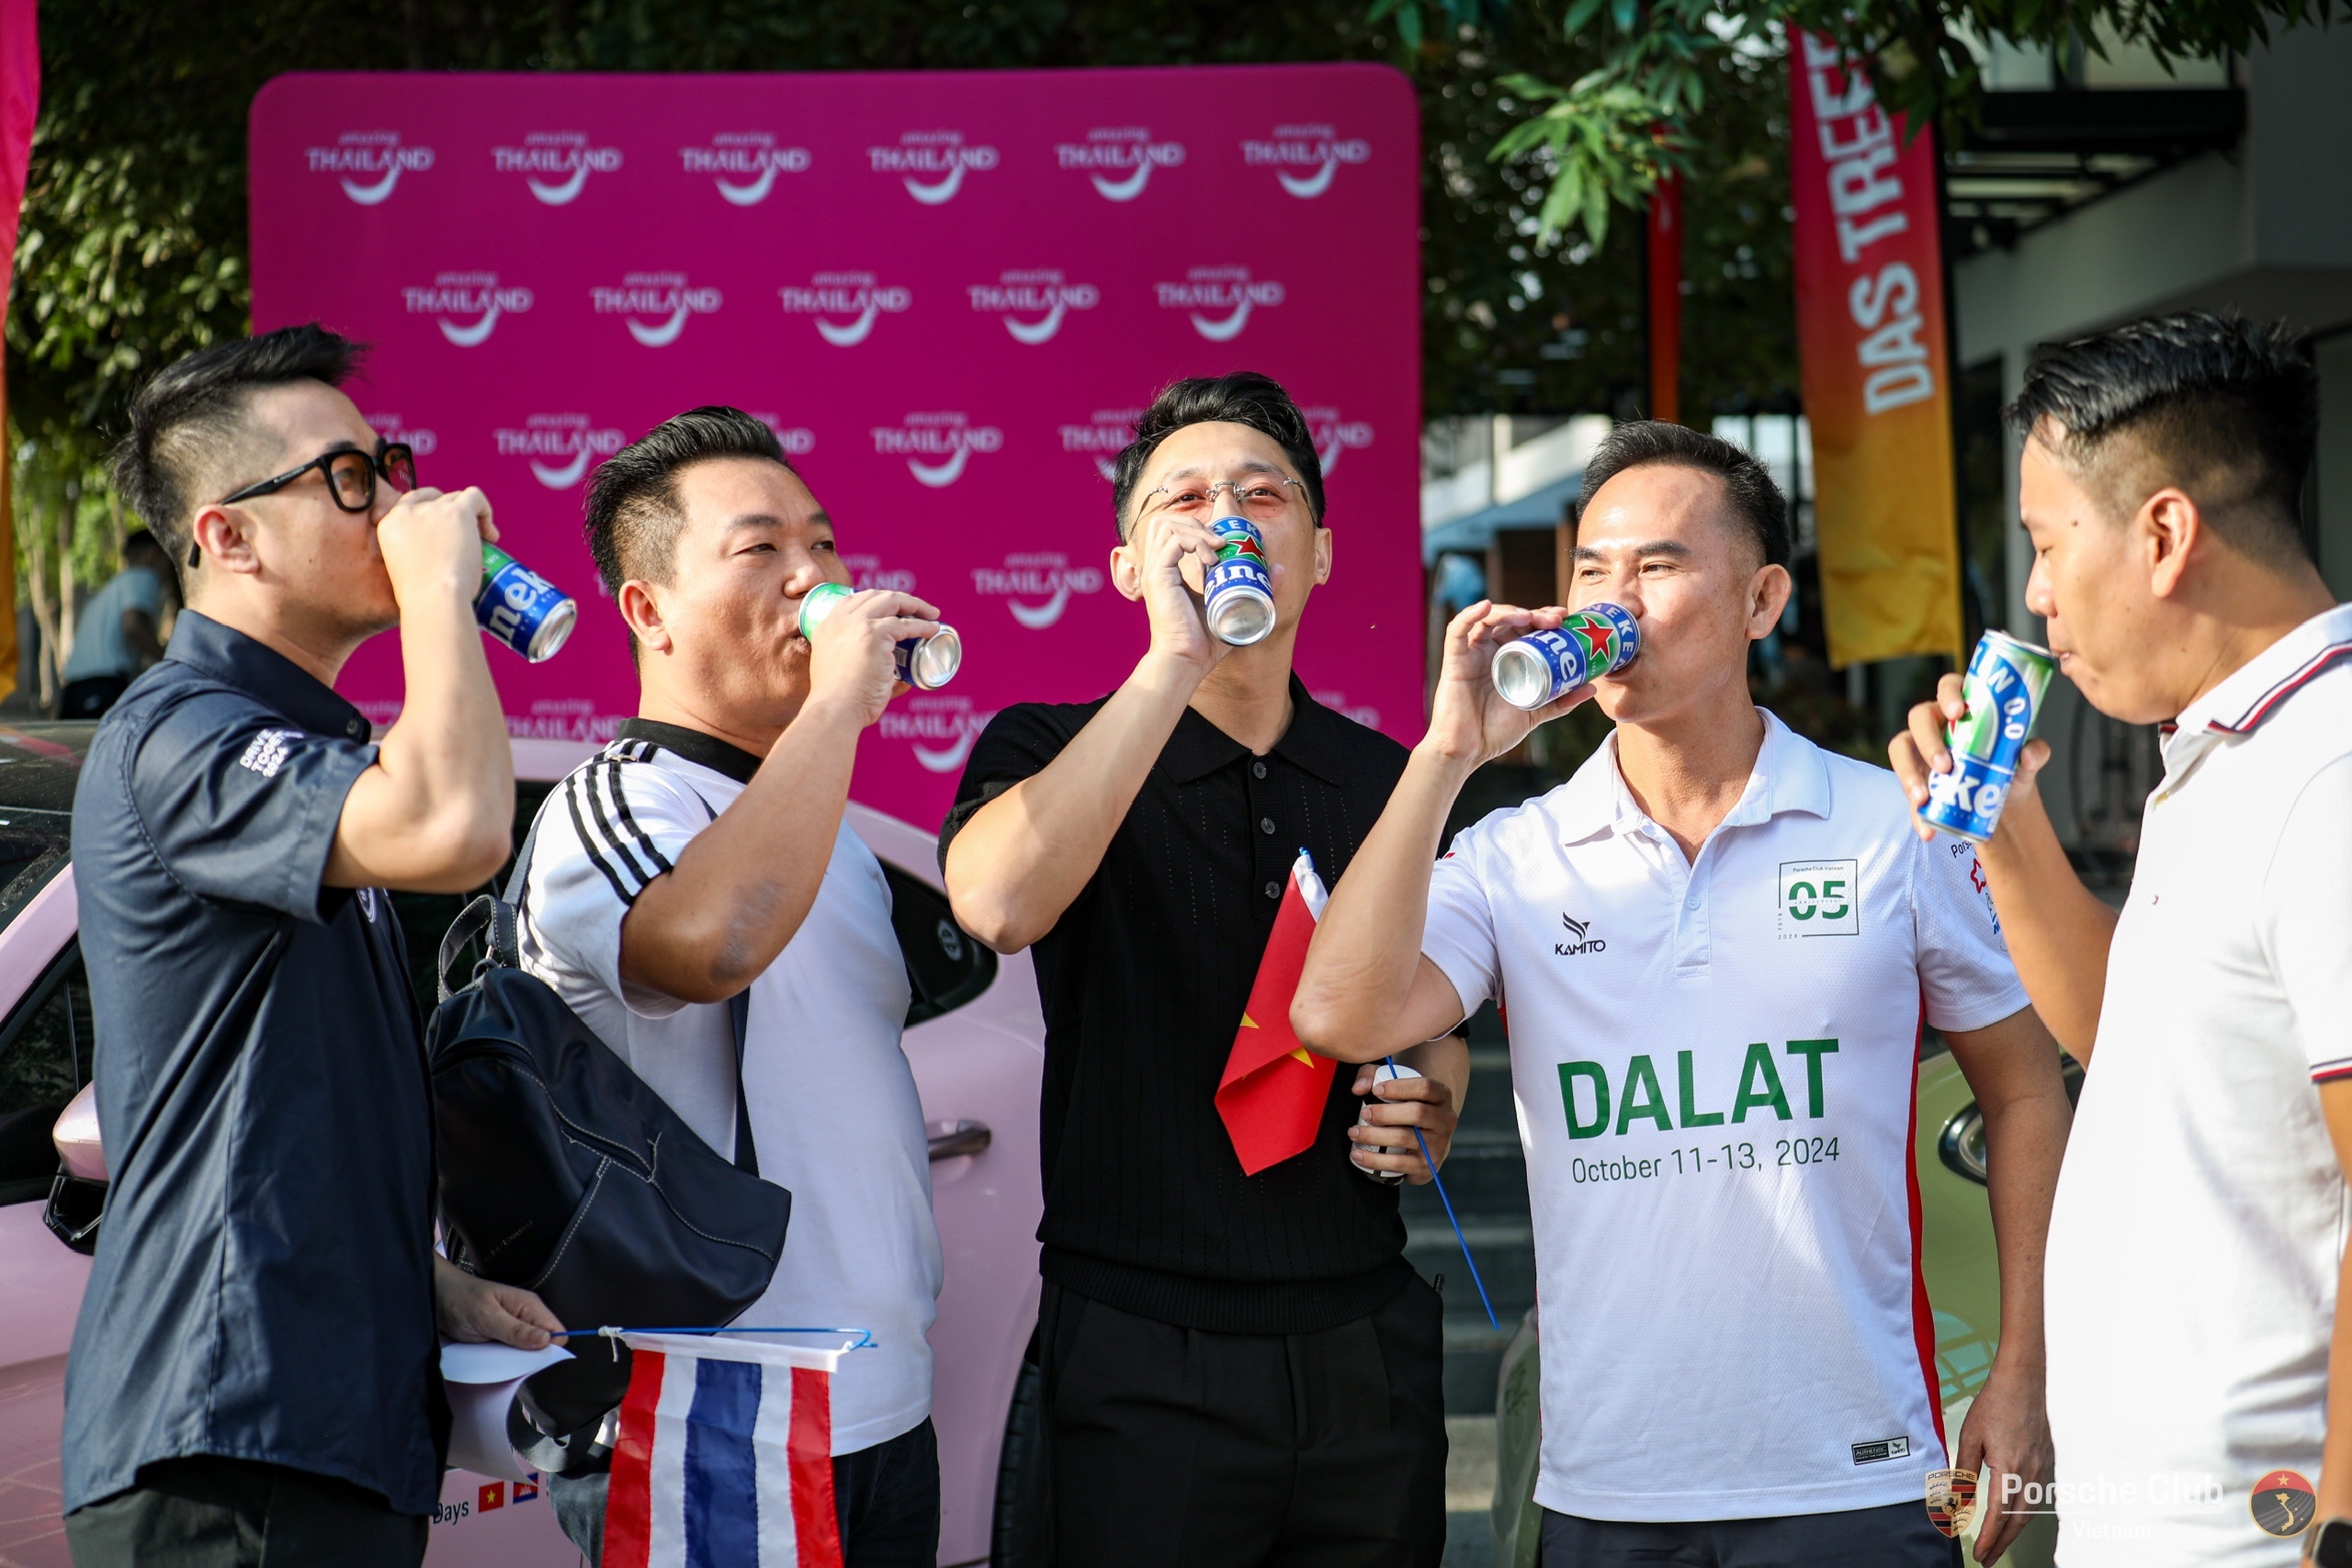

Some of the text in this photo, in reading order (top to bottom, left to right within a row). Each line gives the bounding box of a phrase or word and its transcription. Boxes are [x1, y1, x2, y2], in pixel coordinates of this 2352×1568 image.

[339, 131, 400, 146] amazing
[526, 131, 587, 146] amazing
[713, 131, 775, 146] amazing
[901, 130, 963, 146] amazing
[1088, 127, 1149, 142] amazing
[1274, 124, 1335, 140] amazing
[308, 147, 434, 172] THAILAND
[493, 147, 621, 172] THAILAND
[682, 148, 809, 172] THAILAND
[869, 147, 997, 172] THAILAND
[1057, 143, 1183, 169] THAILAND
[1242, 140, 1368, 165] THAILAND
[435, 272, 498, 288] amazing
[624, 272, 687, 288] amazing
[812, 272, 876, 288] amazing
[1001, 269, 1064, 285] amazing
[1188, 266, 1250, 282] amazing
[404, 288, 532, 314] THAILAND
[593, 288, 720, 314] THAILAND
[781, 288, 910, 314] THAILAND
[969, 286, 1098, 310] THAILAND
[1157, 283, 1283, 308] THAILAND
[1846, 261, 1936, 418] DAS
[526, 413, 590, 429] amazing
[904, 412, 967, 427] amazing
[494, 429, 625, 455] THAILAND
[873, 427, 1001, 453] THAILAND
[1057, 425, 1133, 452] THAIL
[1004, 553, 1068, 569] amazing
[973, 568, 1102, 595] THAILAND
[491, 566, 556, 649] nek
[531, 698, 594, 715] amazing
[909, 695, 971, 712] amazing
[879, 710, 1000, 738] THAILAN
[1788, 880, 1849, 921] 05
[1555, 939, 1606, 956] KAMITO
[1557, 1038, 1839, 1140] DALAT
[1572, 1136, 1840, 1183] October 11-13, 2024
